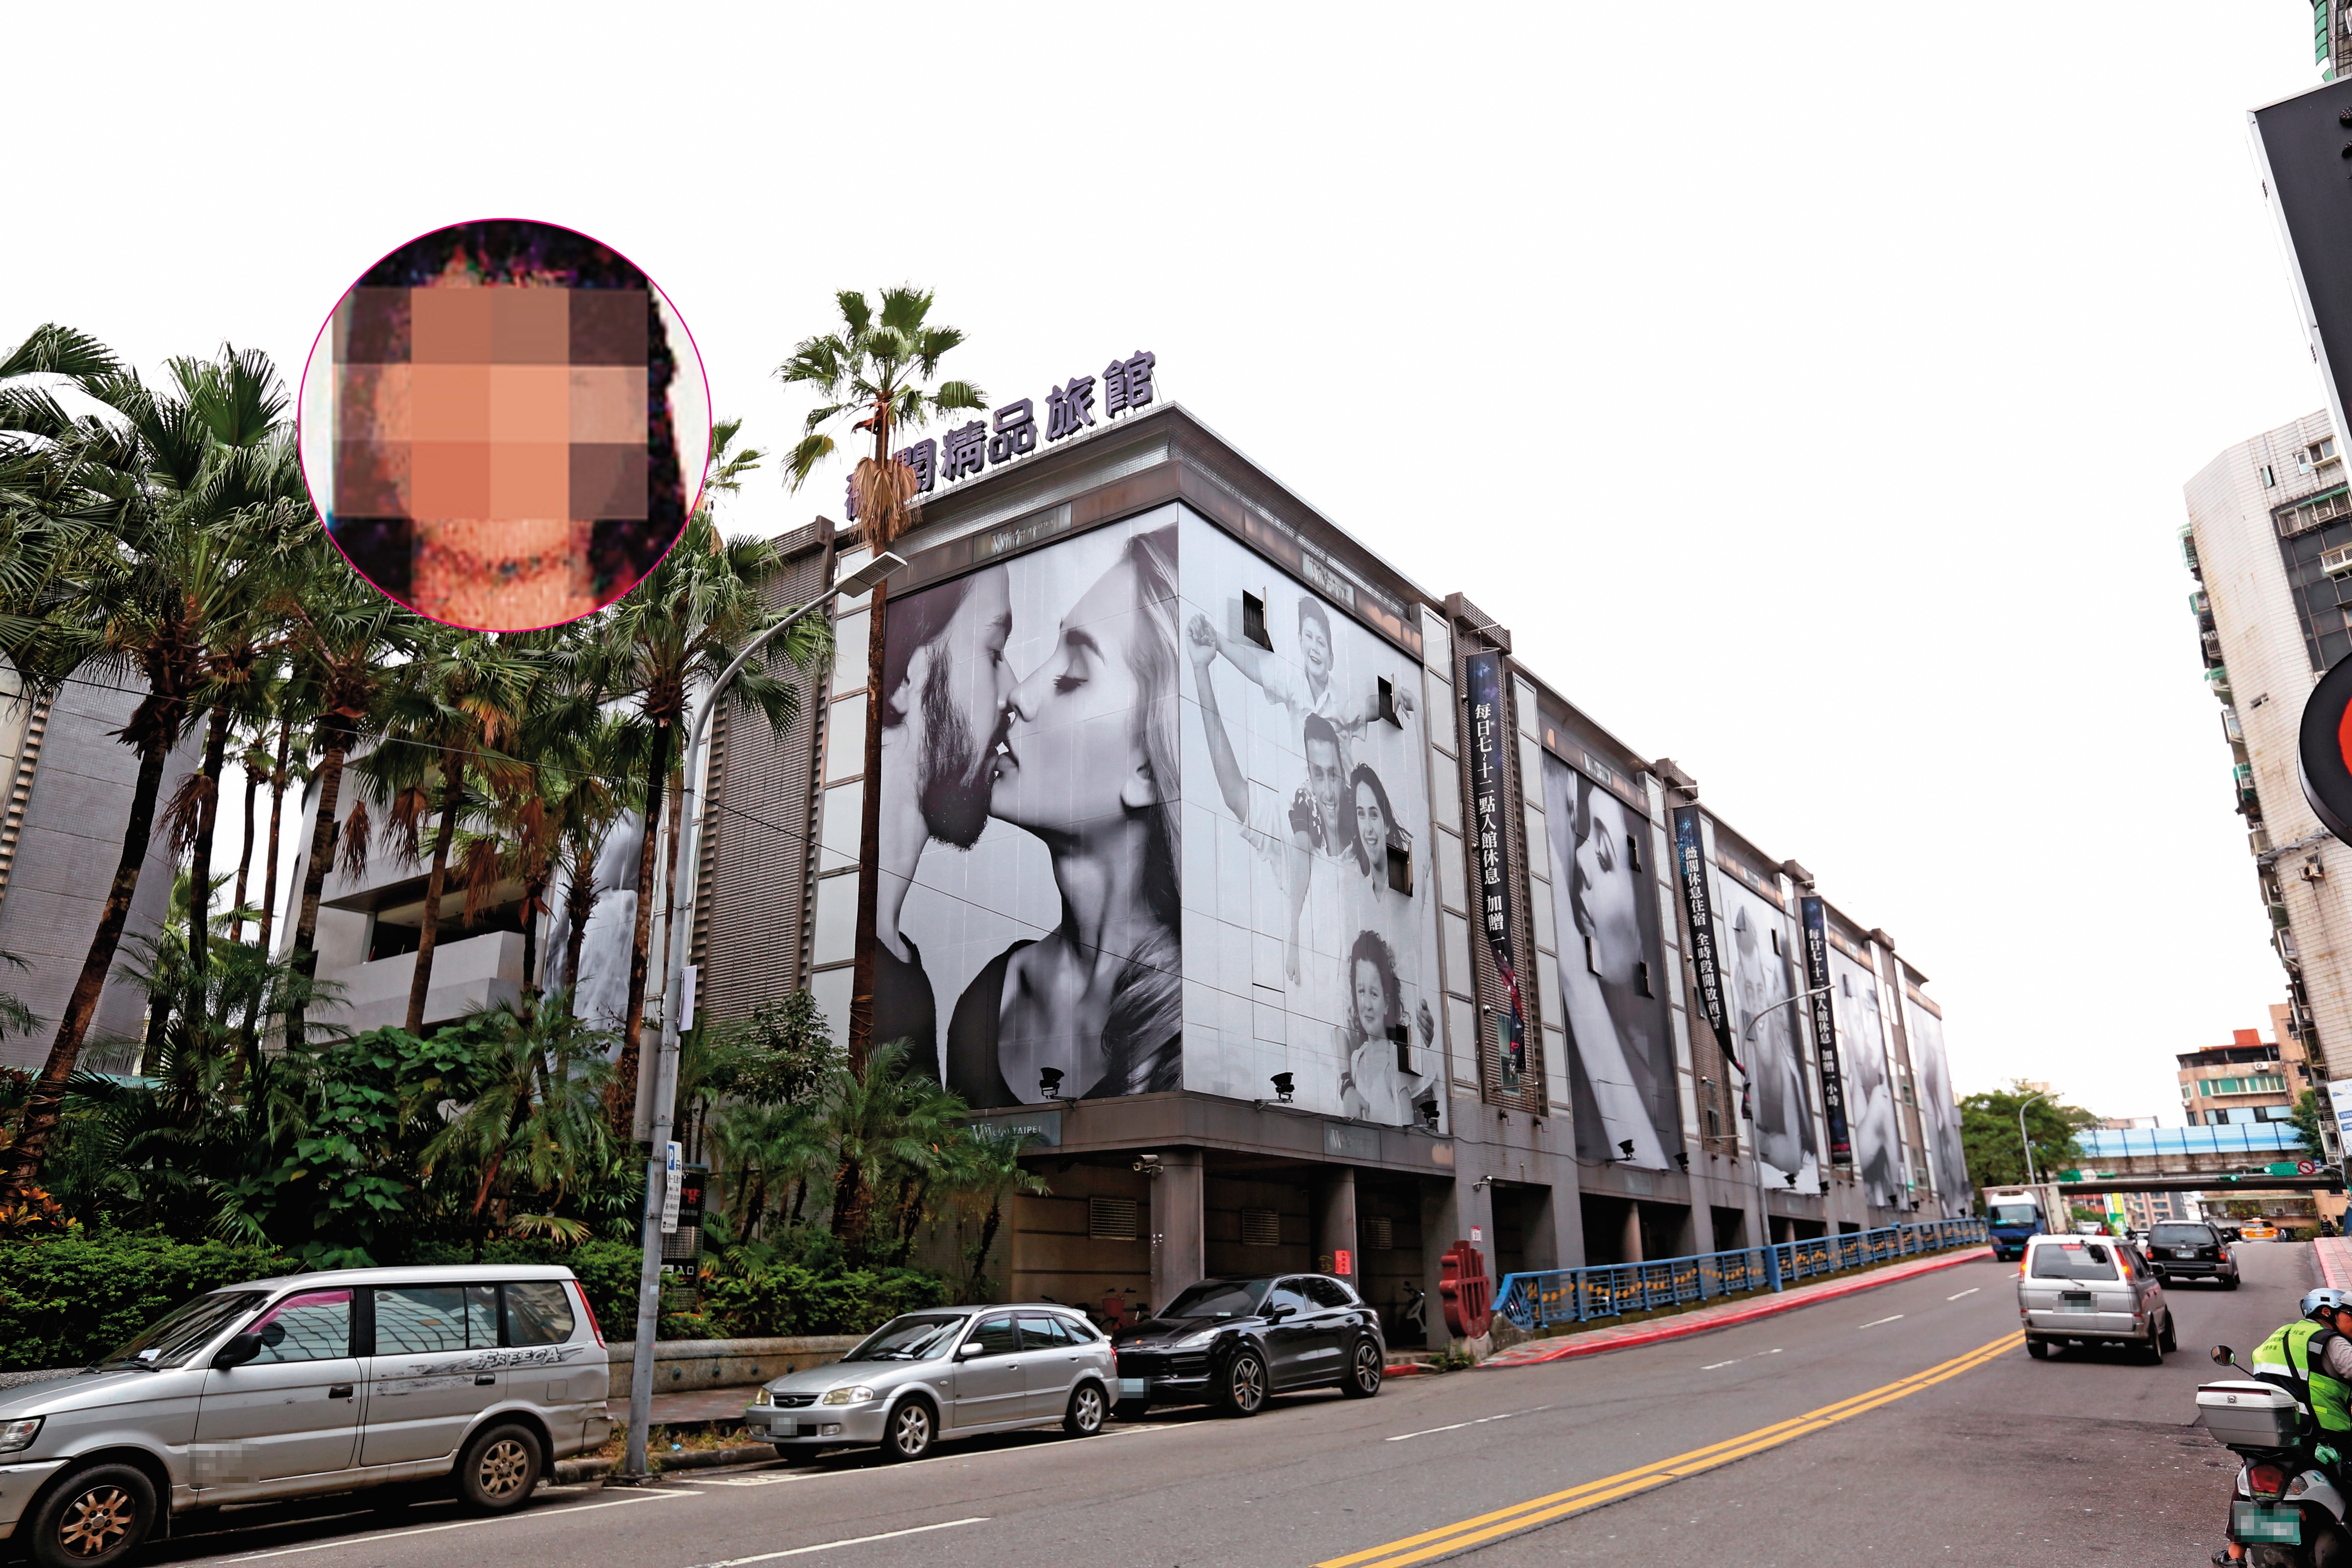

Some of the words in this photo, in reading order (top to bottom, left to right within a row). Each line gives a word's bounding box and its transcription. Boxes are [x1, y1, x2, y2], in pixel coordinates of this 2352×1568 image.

[1013, 1126, 1041, 1134] TAIPEI
[678, 1265, 694, 1275] 入口
[479, 1347, 560, 1368] FREECA
